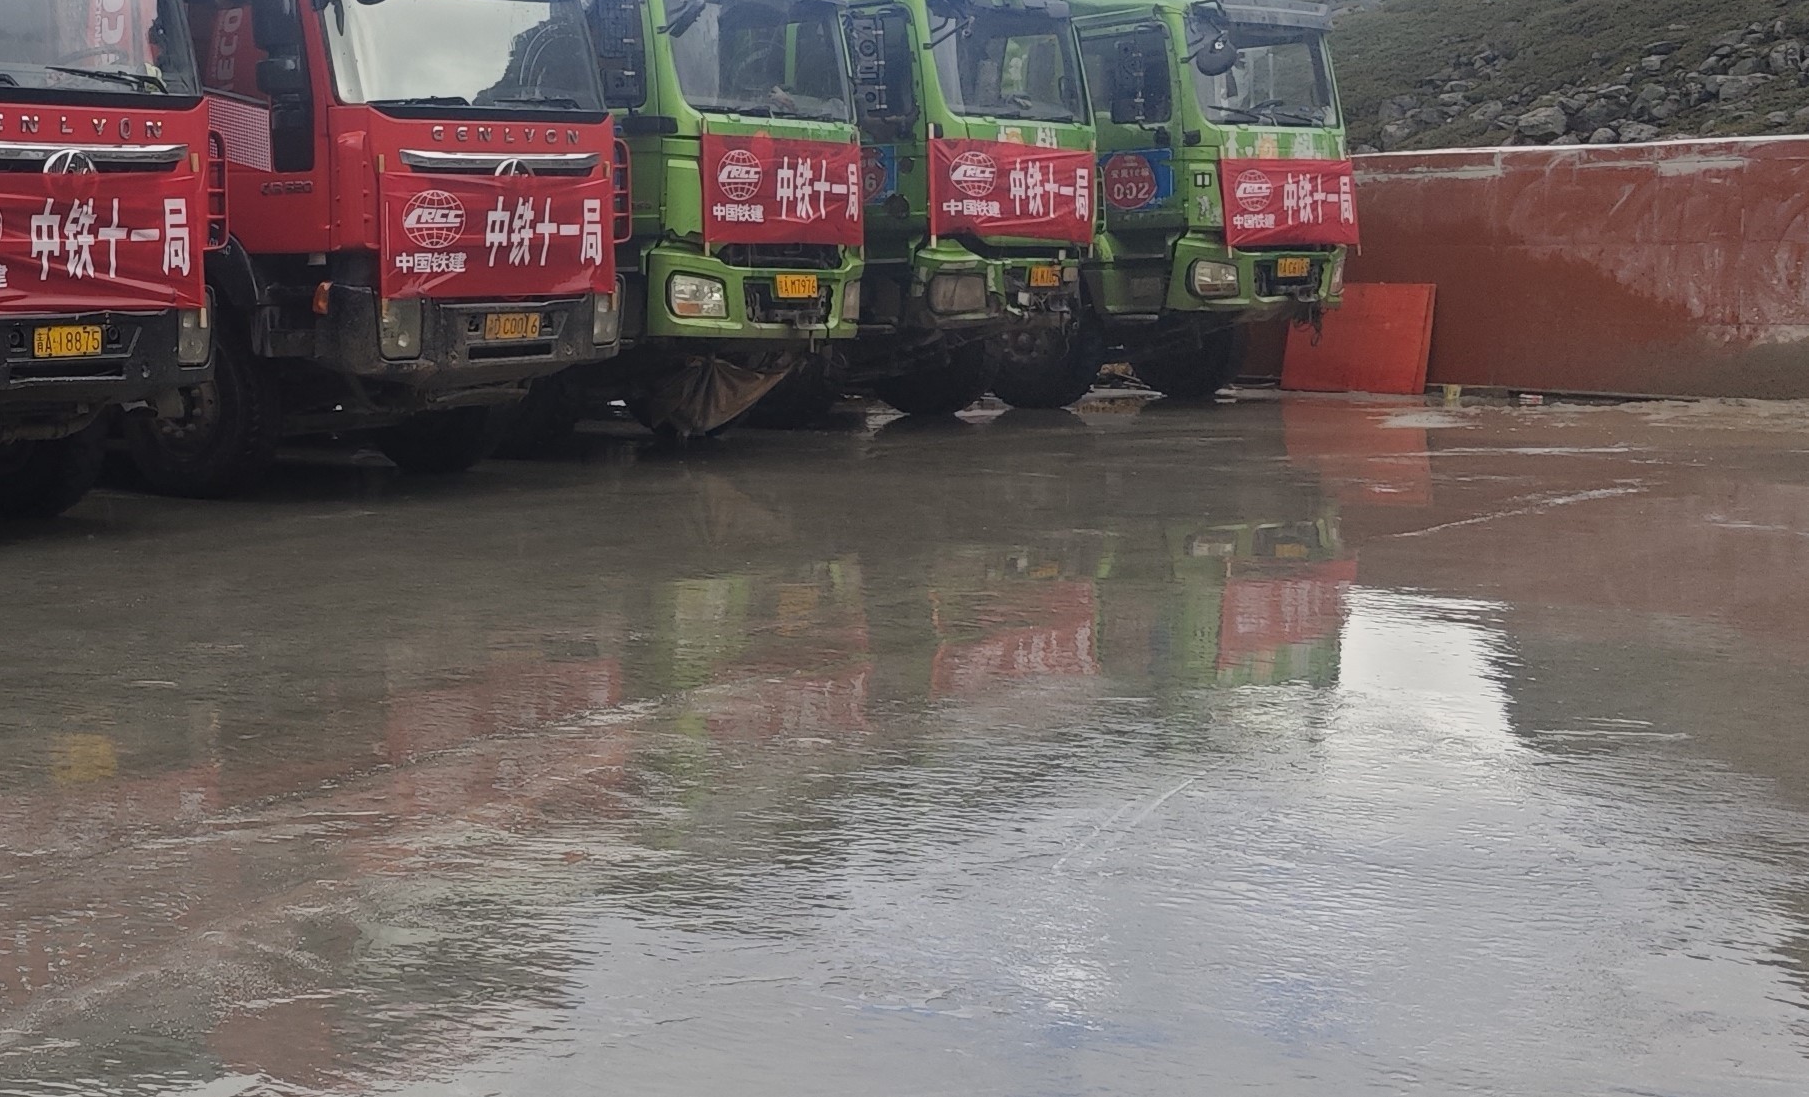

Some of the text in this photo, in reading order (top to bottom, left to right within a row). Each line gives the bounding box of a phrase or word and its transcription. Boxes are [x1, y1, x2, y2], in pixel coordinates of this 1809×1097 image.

[432, 125, 580, 145] GENLYON
[713, 202, 765, 223] 中国铁建
[776, 156, 859, 222] 中铁十一局
[942, 198, 1002, 218] 中国铁建
[1009, 158, 1089, 222] 中铁十一局
[1283, 172, 1354, 225] 中铁十一局
[30, 198, 191, 280] 中铁十一局
[485, 196, 603, 268] 中铁十一局
[395, 251, 468, 273] 中国铁建
